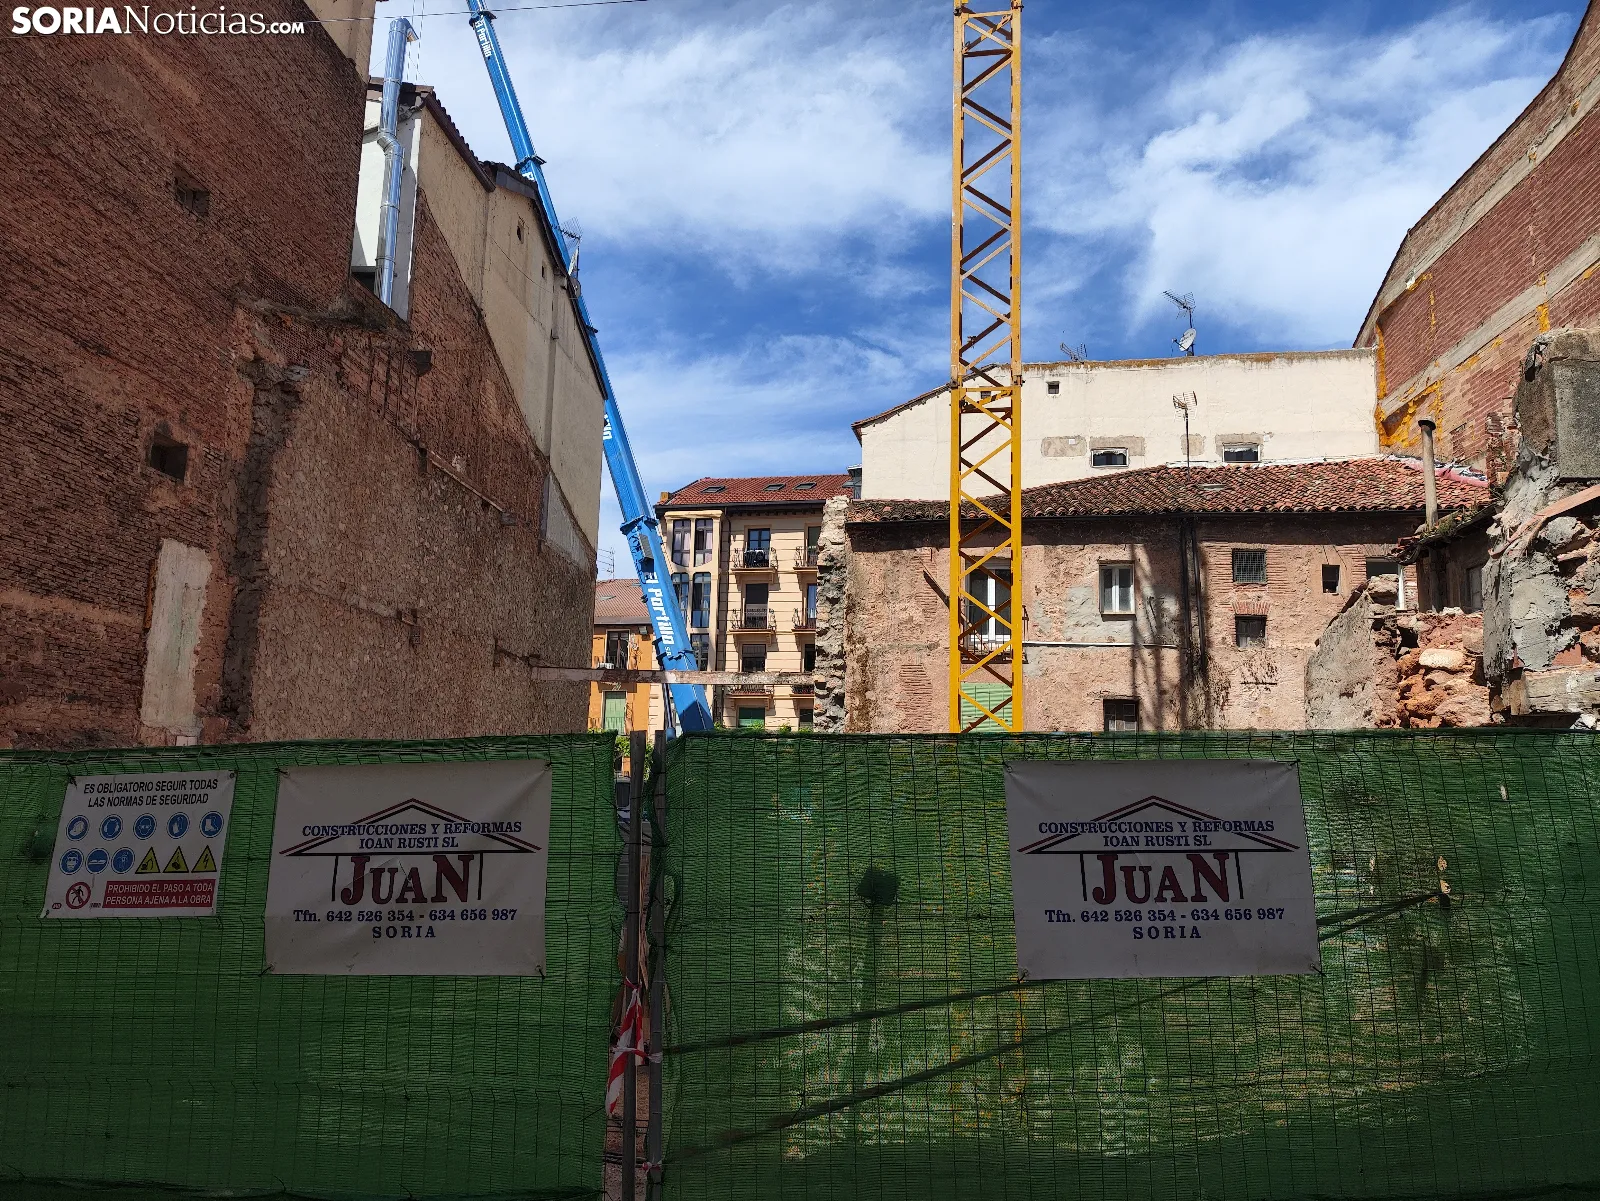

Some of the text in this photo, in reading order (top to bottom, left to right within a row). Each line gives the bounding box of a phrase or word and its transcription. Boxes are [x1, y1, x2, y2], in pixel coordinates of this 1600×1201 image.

[477, 28, 492, 58] Portillo
[647, 587, 675, 645] Portillo
[83, 778, 218, 795] ES OBLIGATORIO SEGUIR TODAS
[87, 793, 209, 808] LAS NORMAS DE SEGURIDAD
[302, 821, 522, 837] CONSTRUCCIONES Y REFORMAS
[1038, 819, 1274, 834] CONSTRUCCIONES Y REFORMAS
[359, 836, 459, 850] IOAN RUSTI SL
[1103, 834, 1212, 848] IOAN RUSTI SL
[340, 854, 475, 905] JUAN
[1092, 852, 1230, 905] JUAN
[107, 882, 213, 893] PROHIBIDO EL PASO A TODA
[105, 894, 211, 905] PERSONA AJENA A LA OBRA
[293, 909, 321, 922] Tfn.
[326, 910, 352, 922] 642
[357, 910, 383, 922] 526
[387, 910, 414, 922] 354
[428, 909, 455, 921] 634
[460, 909, 487, 921] 656
[491, 908, 518, 921] 987
[1045, 909, 1076, 923] Tfn.
[1080, 909, 1109, 922] 642
[1114, 909, 1143, 922] 526
[1147, 909, 1176, 922] 354
[1191, 908, 1220, 921] 634
[1225, 908, 1252, 921] 656
[1257, 907, 1285, 920] 987
[372, 925, 436, 939] SORIA
[1133, 926, 1202, 940] SORIA
